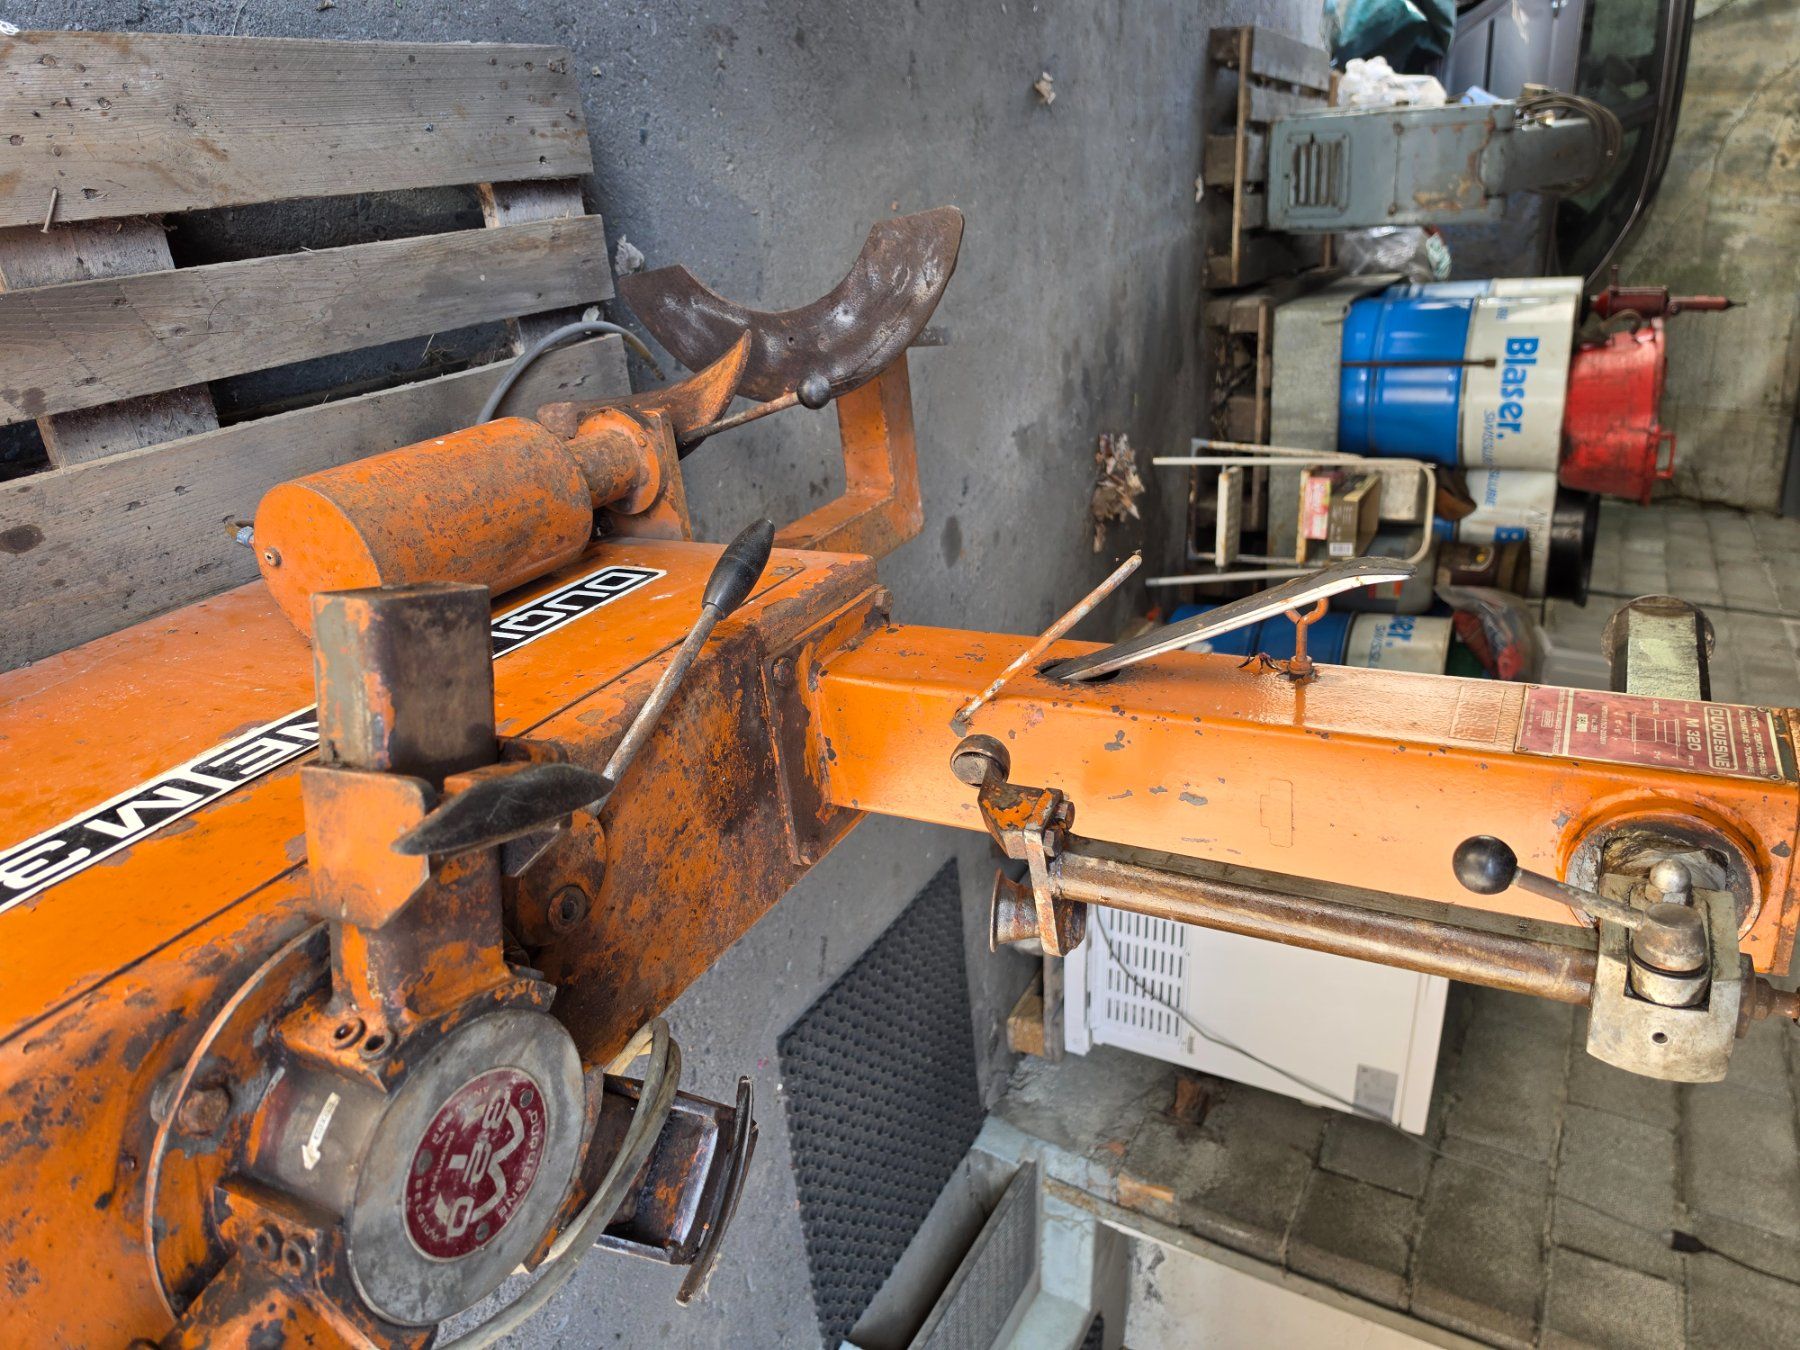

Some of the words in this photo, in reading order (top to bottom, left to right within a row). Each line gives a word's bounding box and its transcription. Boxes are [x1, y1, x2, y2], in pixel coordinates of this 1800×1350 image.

[1496, 336, 1540, 440] Blaser.
[1686, 717, 1700, 728] M
[1686, 729, 1702, 751] 320
[1709, 708, 1730, 769] DUQUESNE
[83, 785, 204, 839] M
[429, 1131, 455, 1193] Patented
[449, 1088, 511, 1238] 320
[498, 1108, 540, 1219] DUQUESNE
[414, 1178, 440, 1242] BELGIUM
